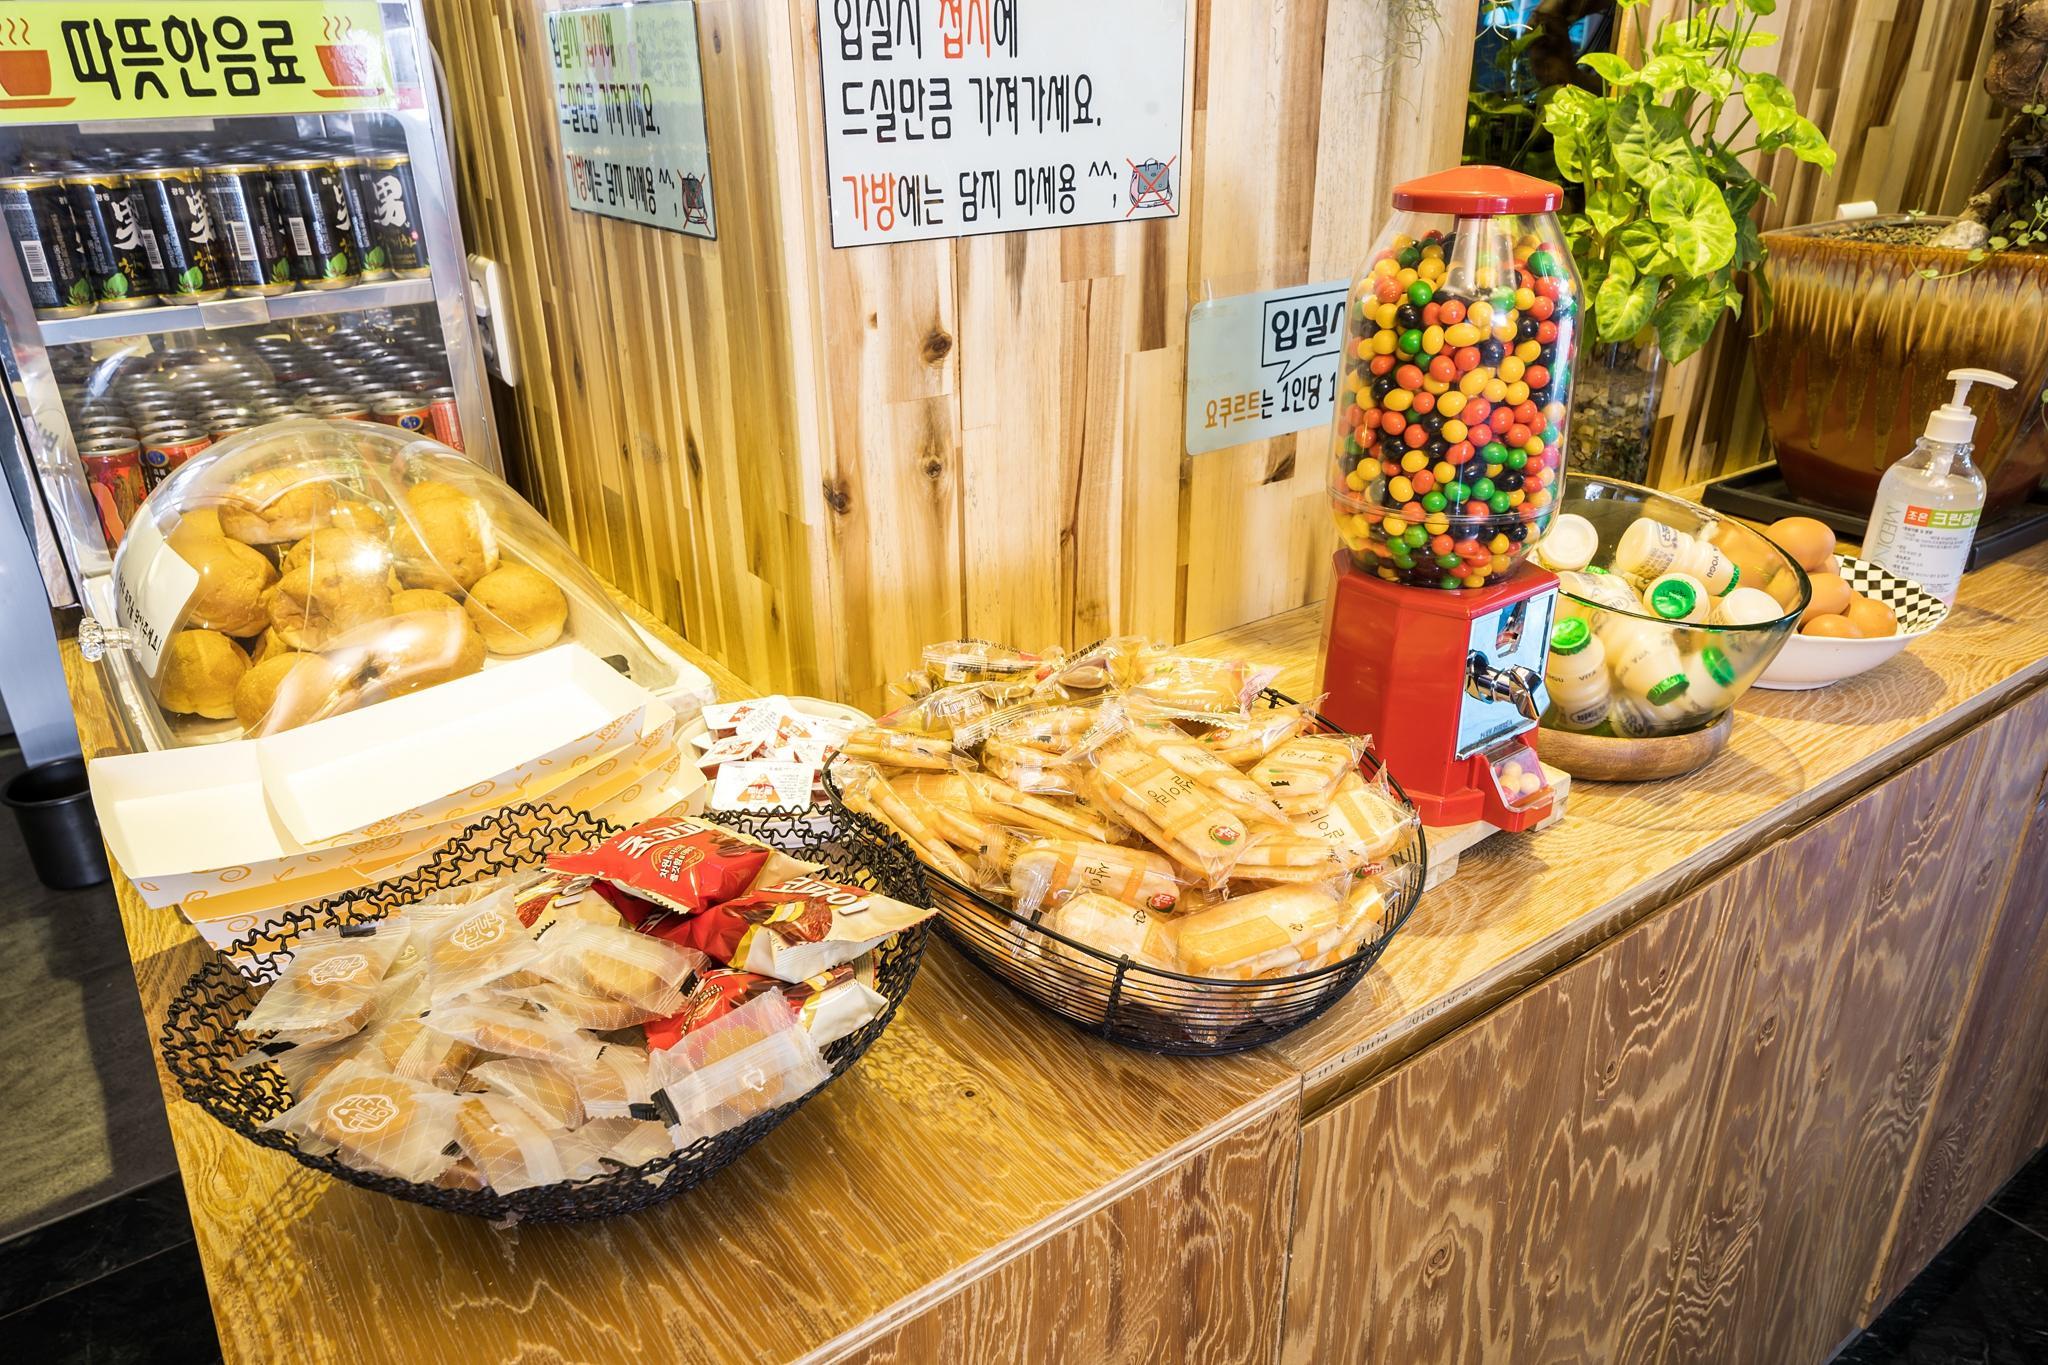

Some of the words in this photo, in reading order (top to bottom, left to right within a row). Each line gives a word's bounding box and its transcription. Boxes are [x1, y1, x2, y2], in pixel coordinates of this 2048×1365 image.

[559, 83, 598, 134] 드실만큼
[599, 82, 660, 138] 가져가세요.
[842, 77, 953, 143] 드실만큼
[968, 73, 1101, 136] 가져가세요.
[567, 154, 604, 203] 가방에는
[604, 162, 625, 208] 담지
[626, 166, 657, 215] 마세용
[842, 171, 944, 231] 가방에는
[959, 169, 1001, 222] 담지
[1015, 163, 1077, 216] 마세용
[1205, 388, 1274, 429] 요쿠르트는
[1281, 374, 1323, 413] 1인당
[1084, 862, 1111, 892] 쌀이
